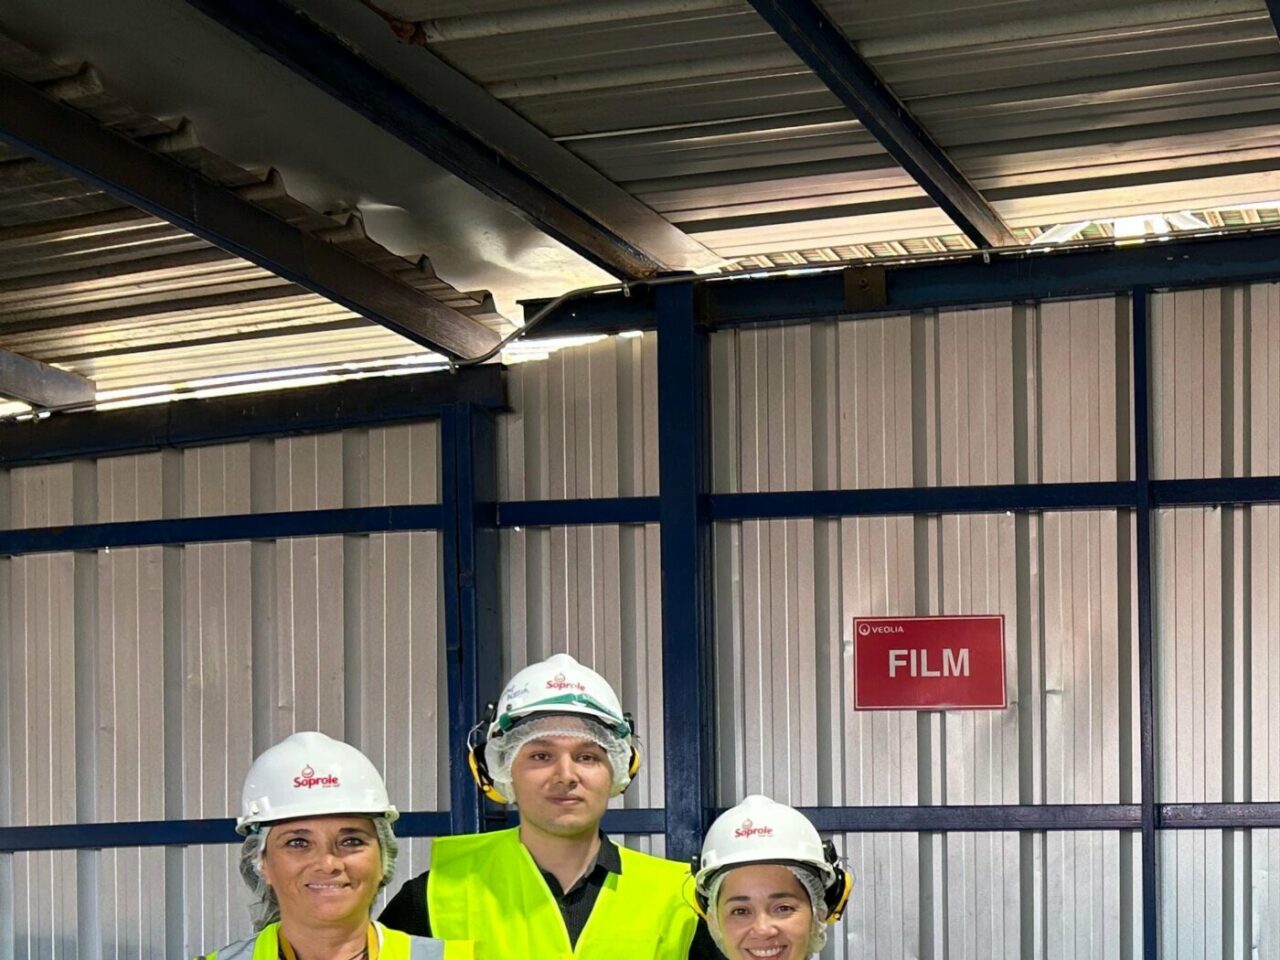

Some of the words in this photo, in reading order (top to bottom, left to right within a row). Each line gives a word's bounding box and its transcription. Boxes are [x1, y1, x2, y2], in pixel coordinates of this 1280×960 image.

[872, 626, 904, 634] VEOLIA
[888, 648, 970, 678] FILM
[545, 680, 586, 692] Soprole
[293, 775, 339, 789] Soprole
[734, 826, 773, 838] Soprole
